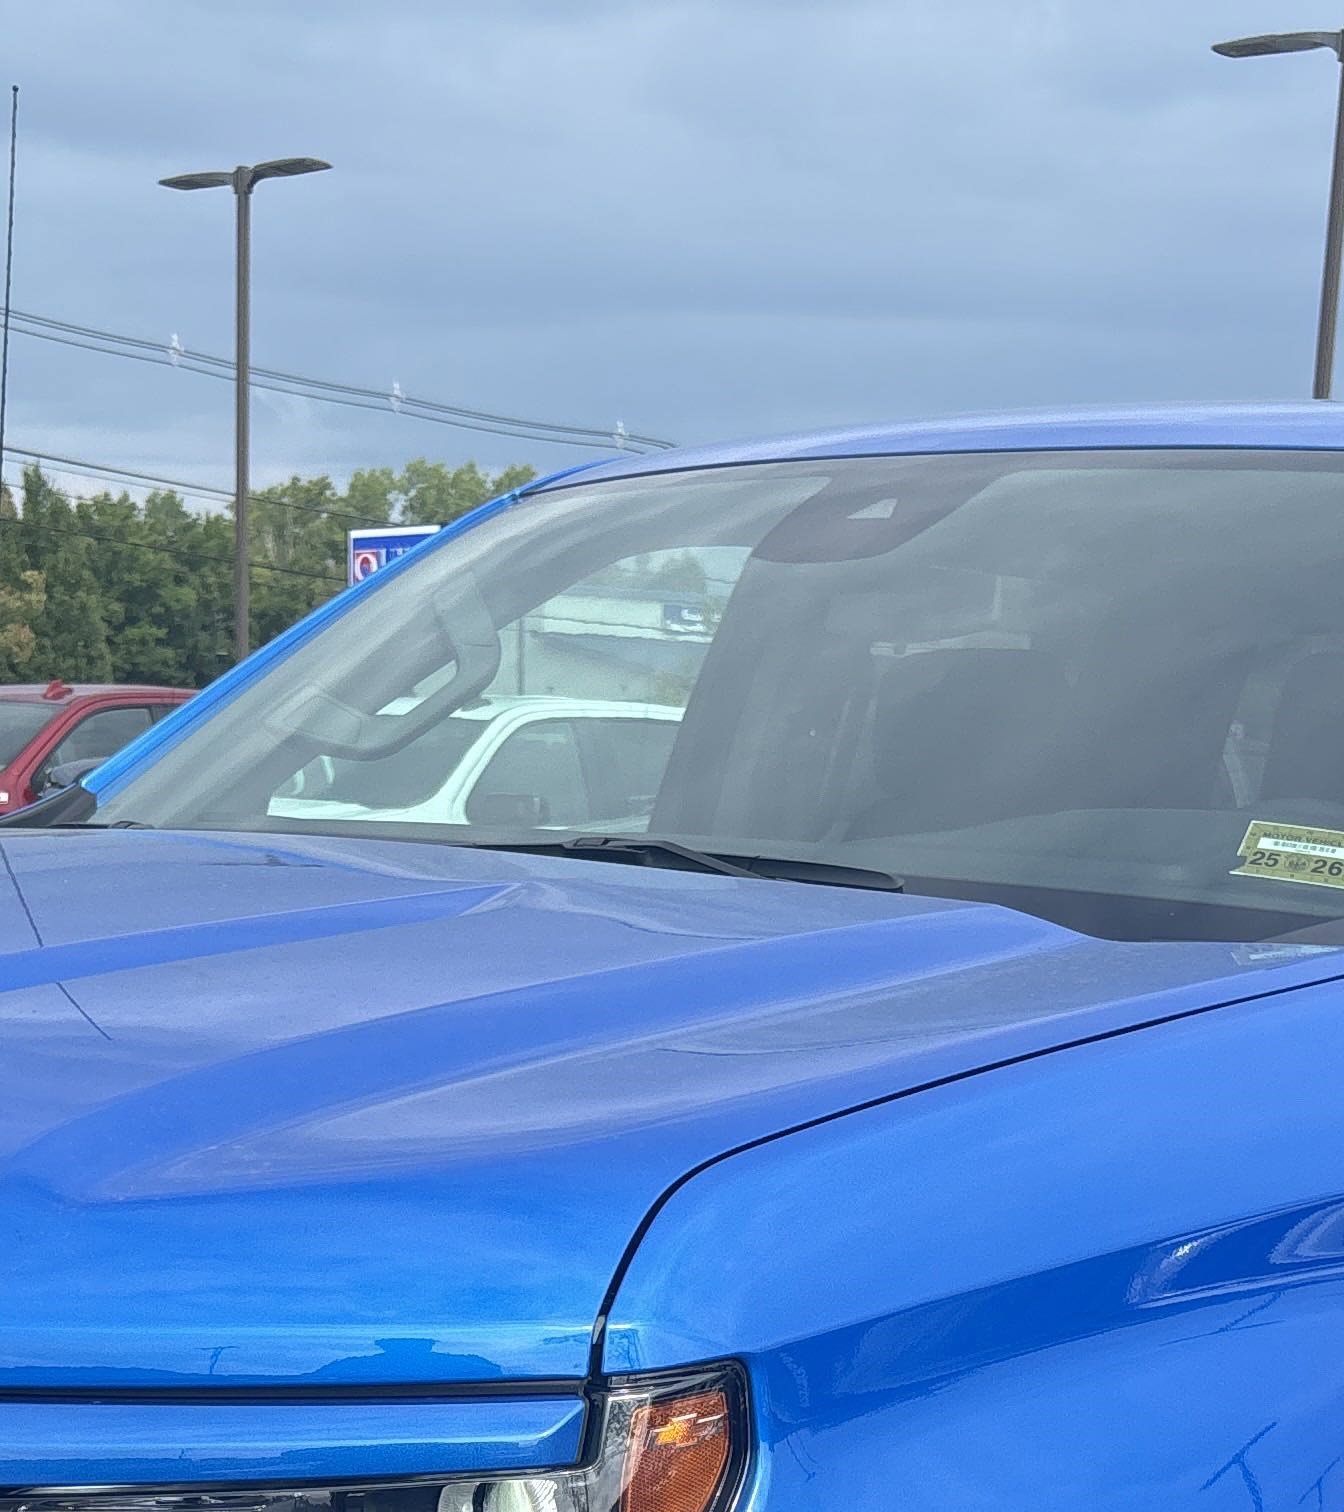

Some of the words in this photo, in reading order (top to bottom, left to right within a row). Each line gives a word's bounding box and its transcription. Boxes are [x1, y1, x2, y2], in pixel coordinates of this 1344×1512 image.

[1262, 831, 1303, 844] MOTOR
[1248, 851, 1281, 868] 25
[1311, 859, 1344, 876] 26
